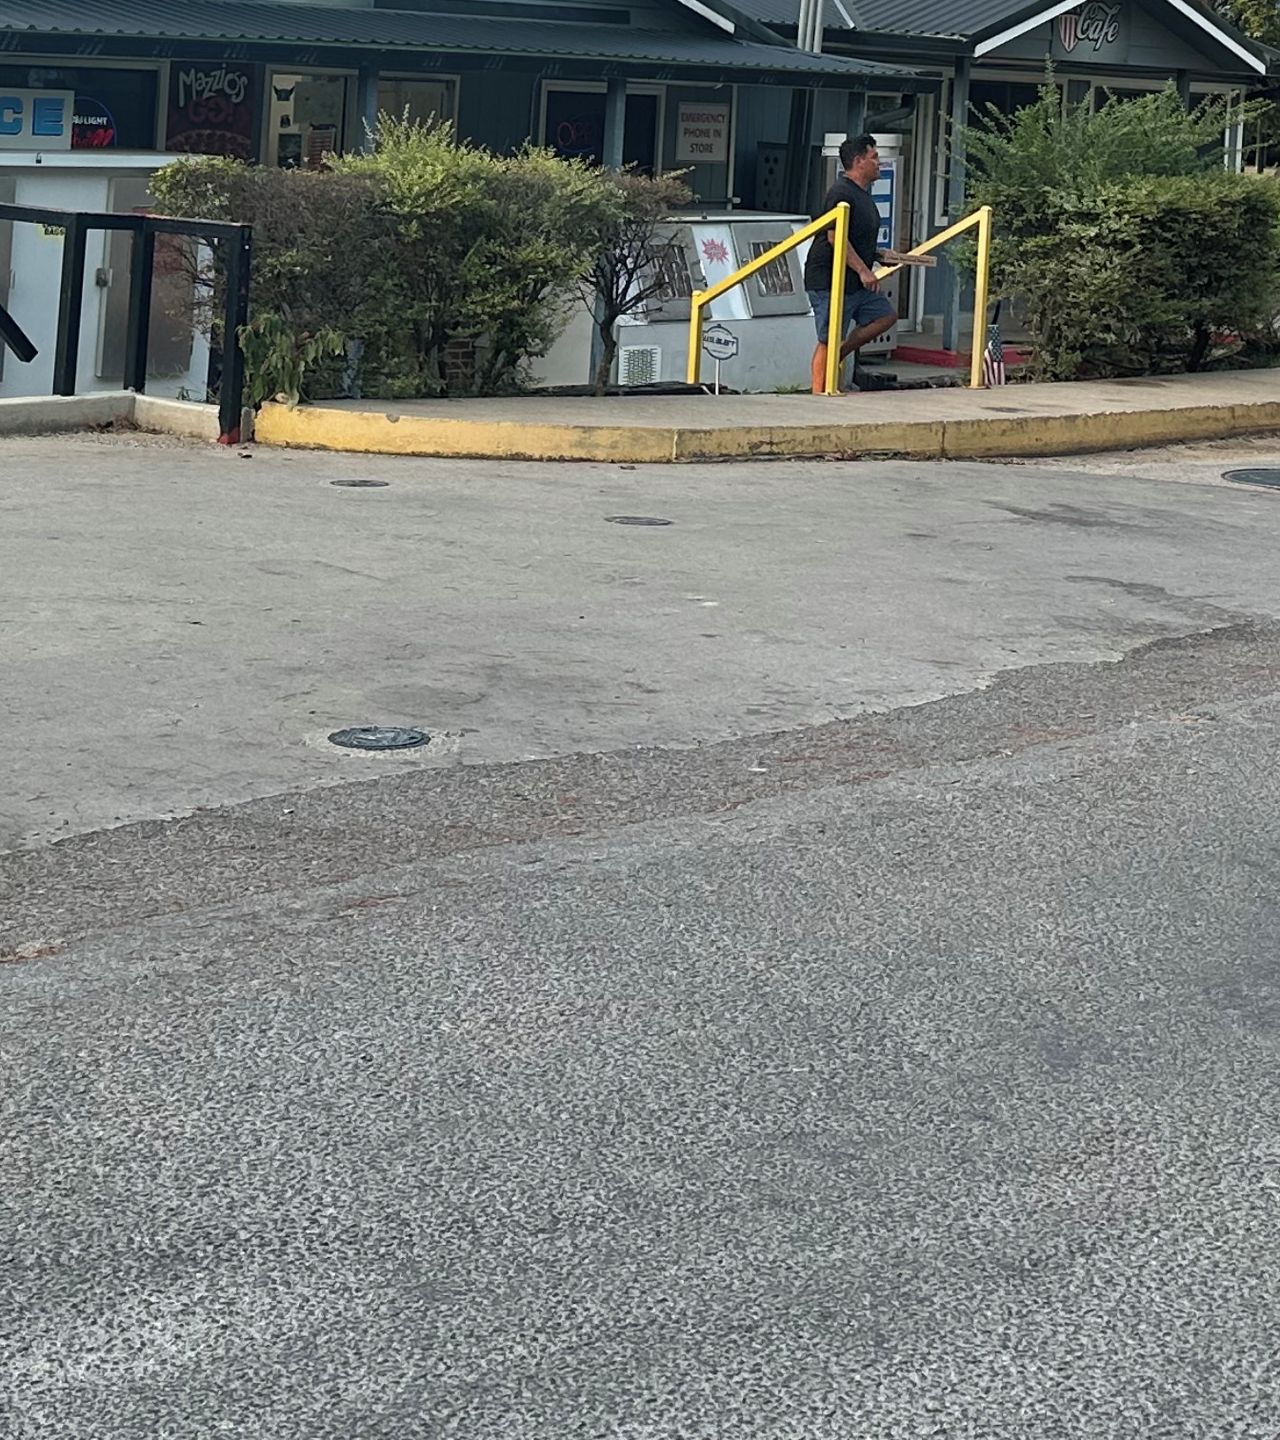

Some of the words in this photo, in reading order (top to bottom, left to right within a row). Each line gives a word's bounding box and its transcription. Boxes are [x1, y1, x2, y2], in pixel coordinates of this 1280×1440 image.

[680, 111, 726, 124] EMERGENCY
[683, 128, 711, 139] PHONE
[713, 129, 722, 139] IN
[689, 142, 713, 154] STORE
